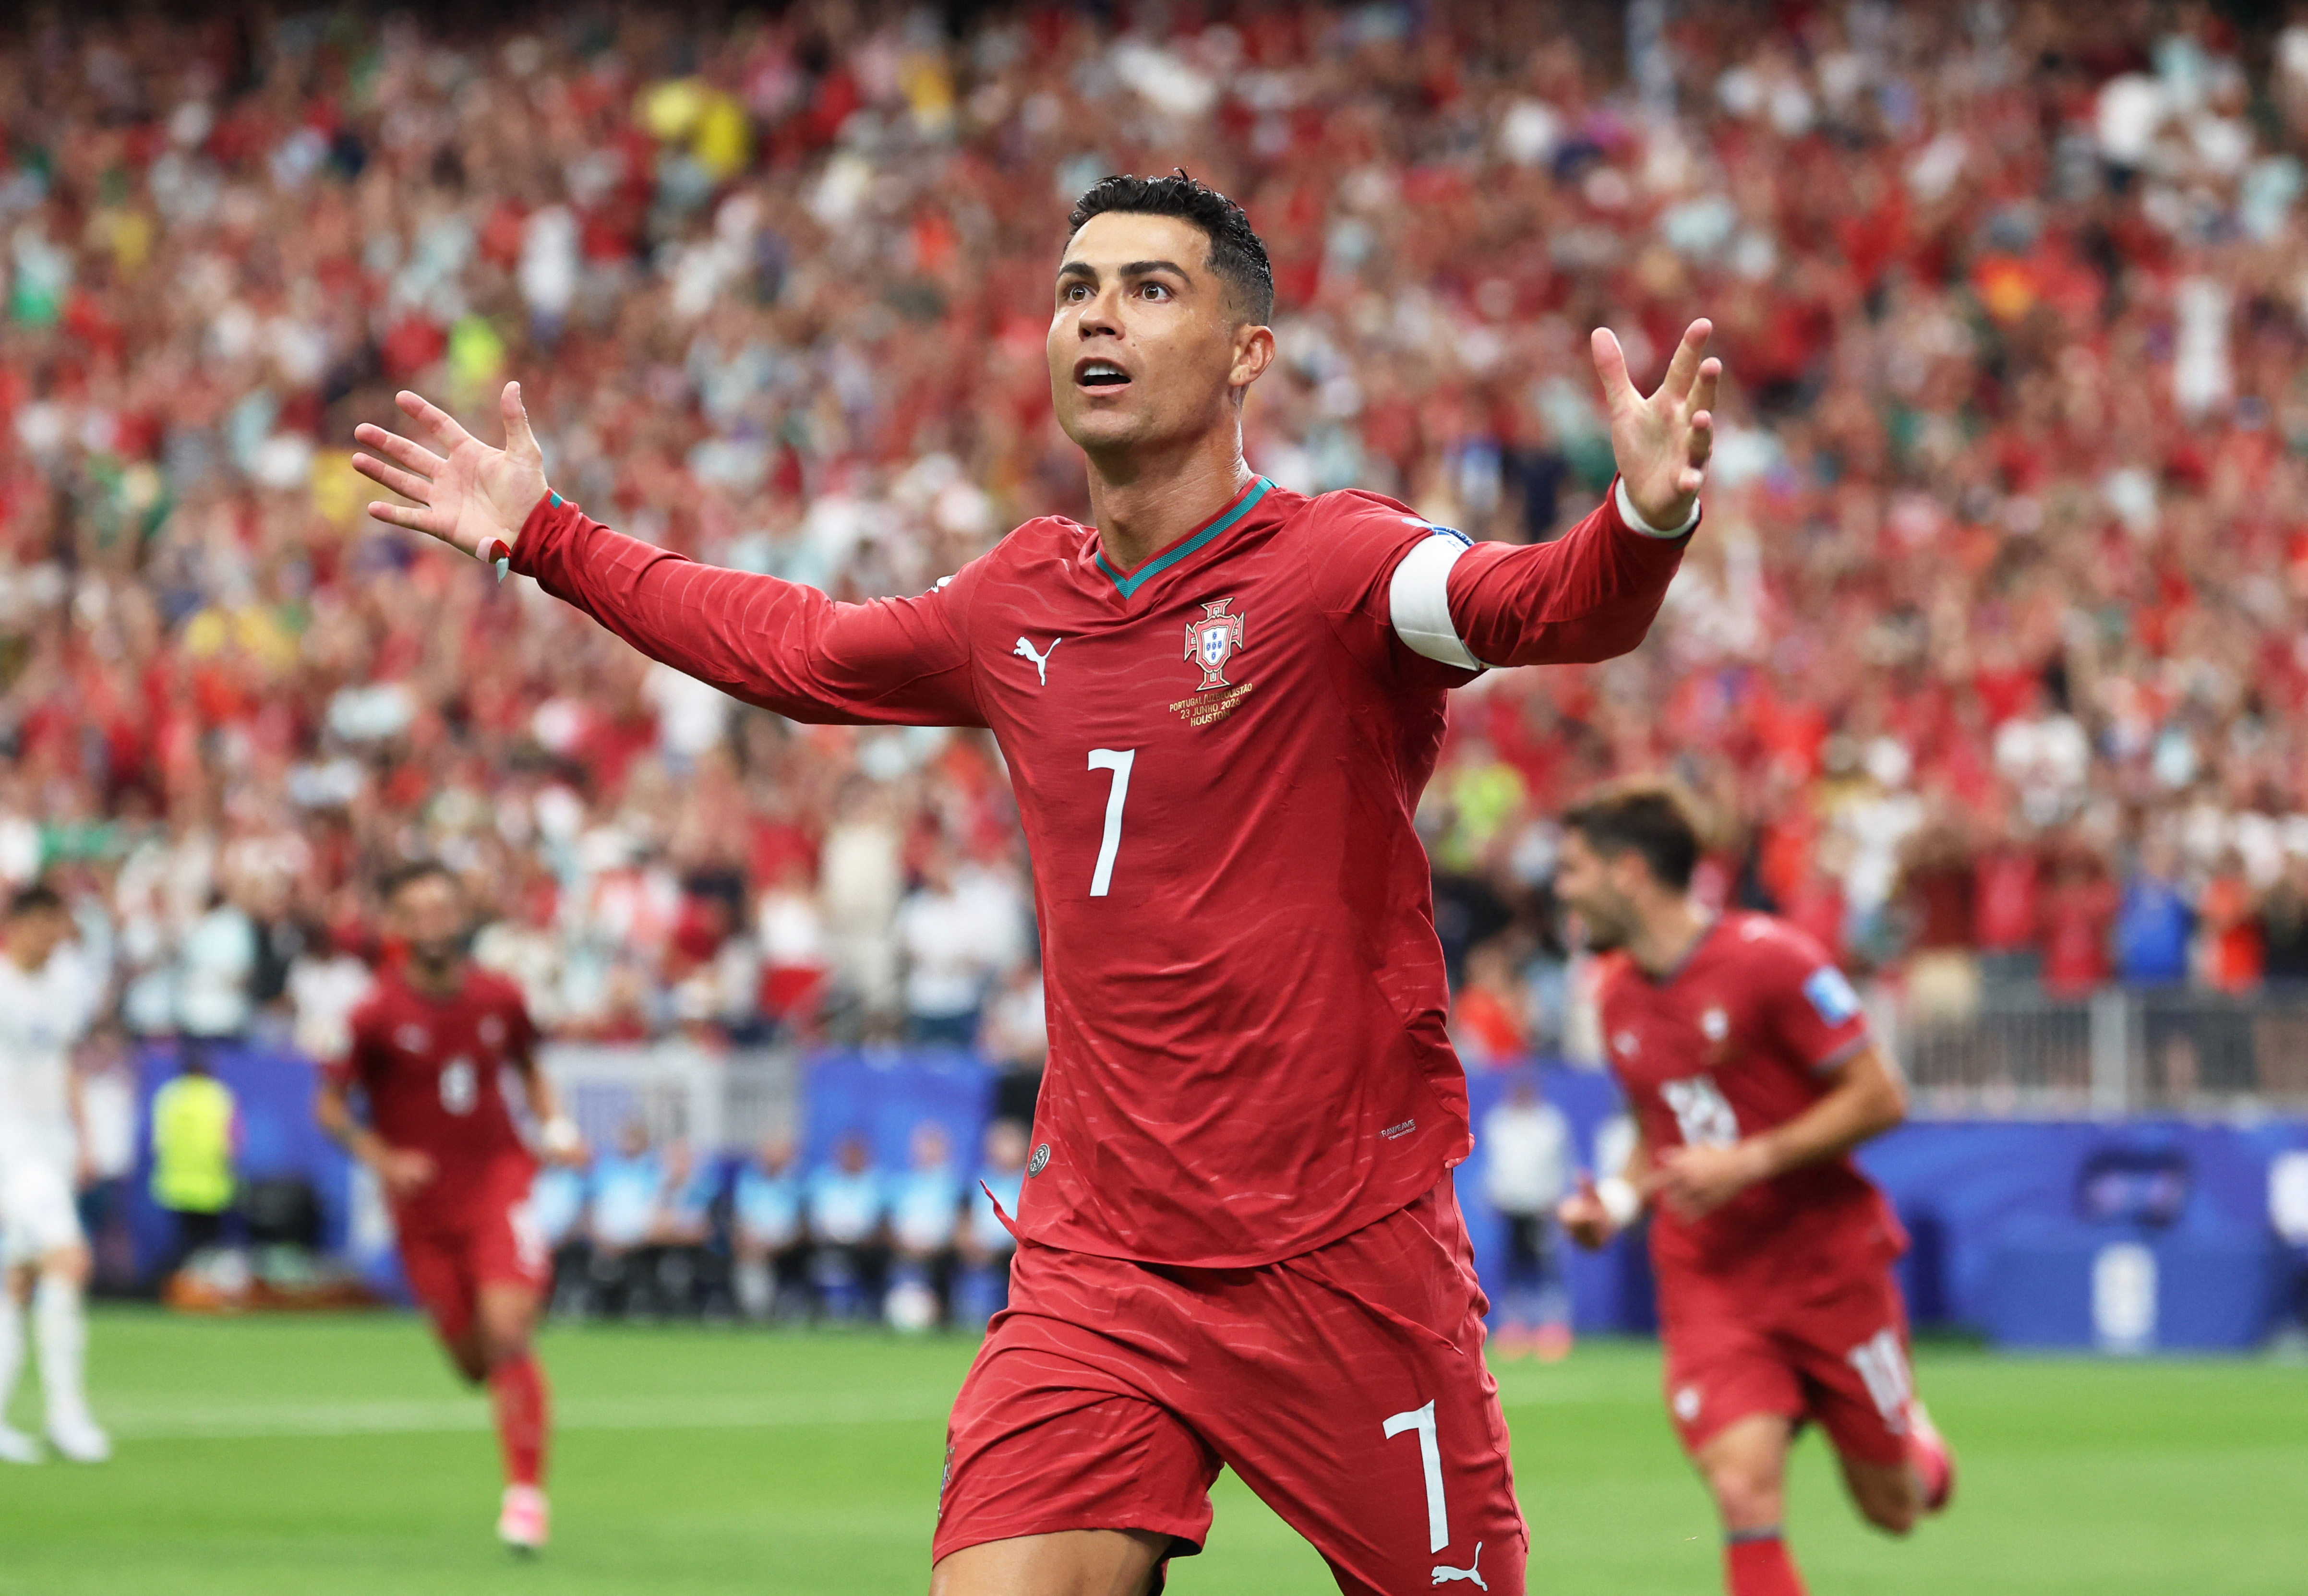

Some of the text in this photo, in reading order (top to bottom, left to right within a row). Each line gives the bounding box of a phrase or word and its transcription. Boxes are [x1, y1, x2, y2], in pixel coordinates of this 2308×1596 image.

[1180, 697, 1240, 720] 23 JUNHO 2026
[1190, 709, 1231, 727] HOUSTON
[1087, 748, 1135, 897] 7
[1379, 1119, 1415, 1137] RAWEAVE
[1382, 1399, 1449, 1554] 7
